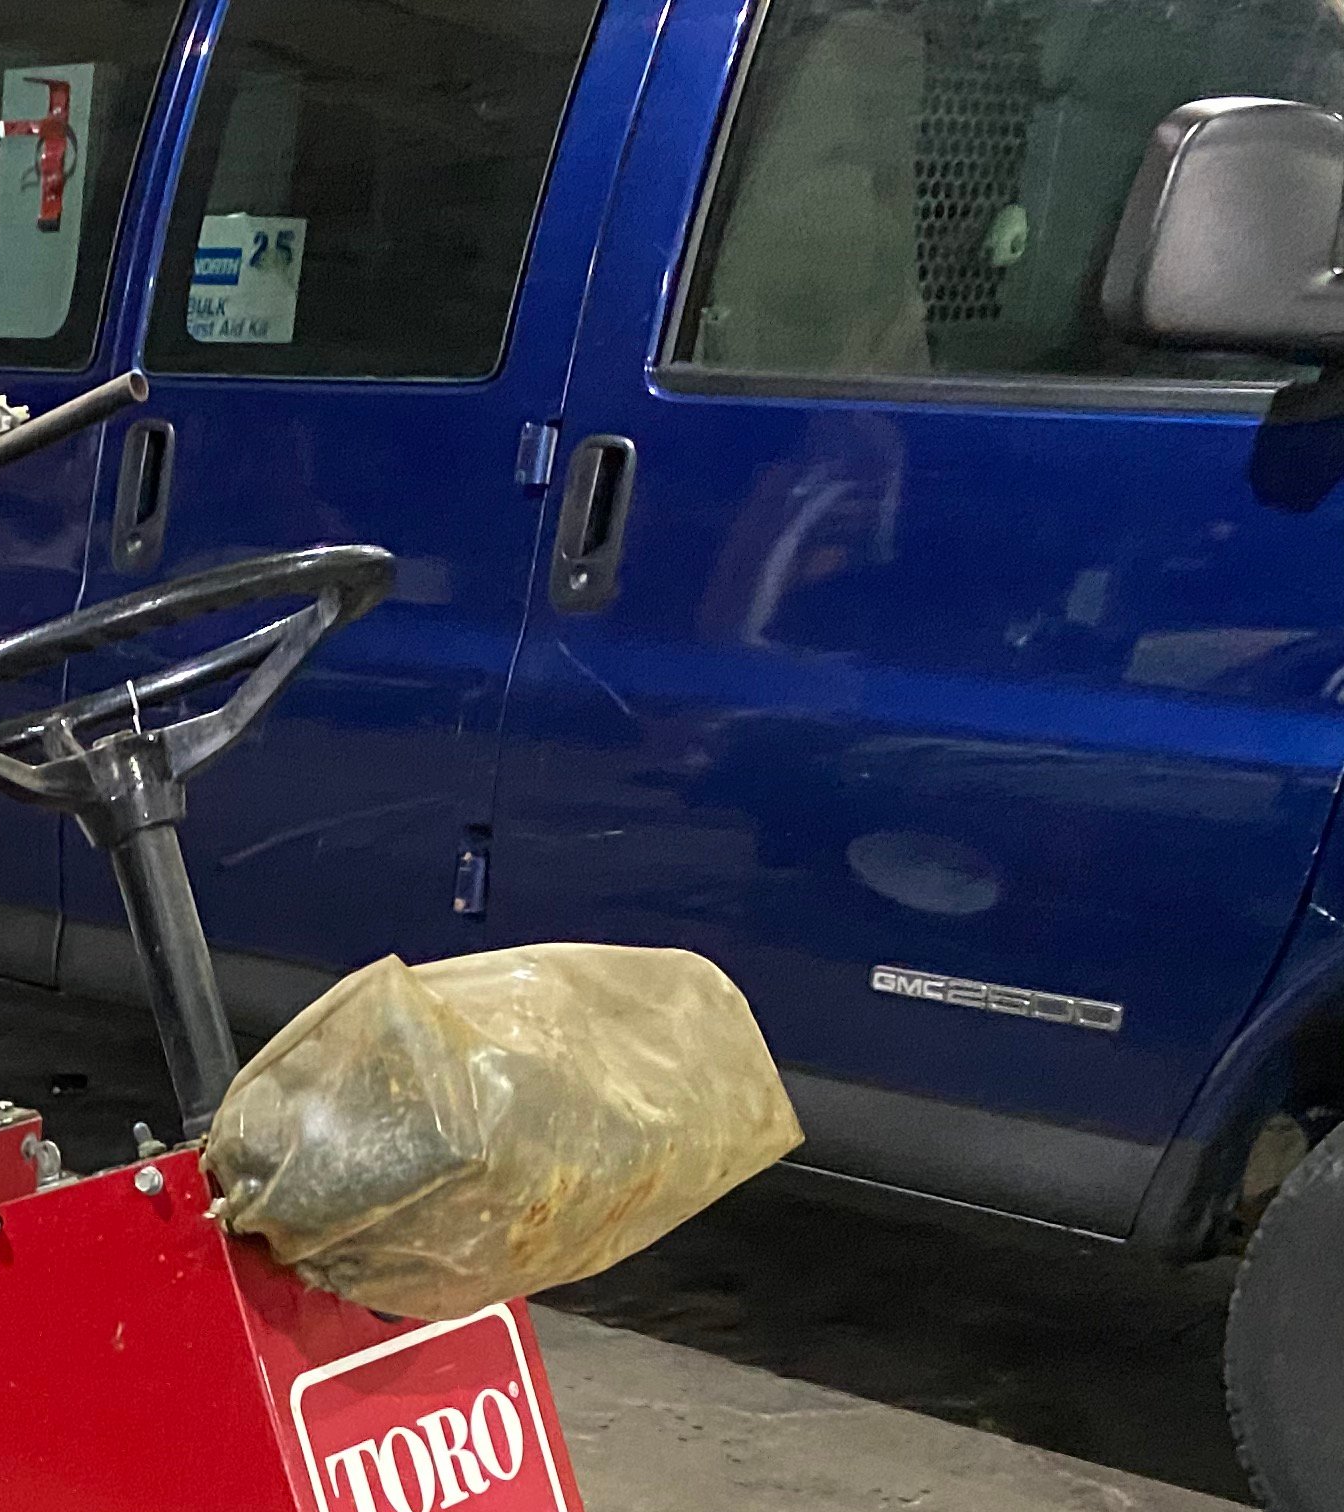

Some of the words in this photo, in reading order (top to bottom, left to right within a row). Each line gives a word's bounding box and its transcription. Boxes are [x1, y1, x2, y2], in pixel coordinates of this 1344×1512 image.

[194, 257, 240, 276] NORTH
[872, 972, 944, 1001] GMC
[947, 980, 1123, 1032] 2500
